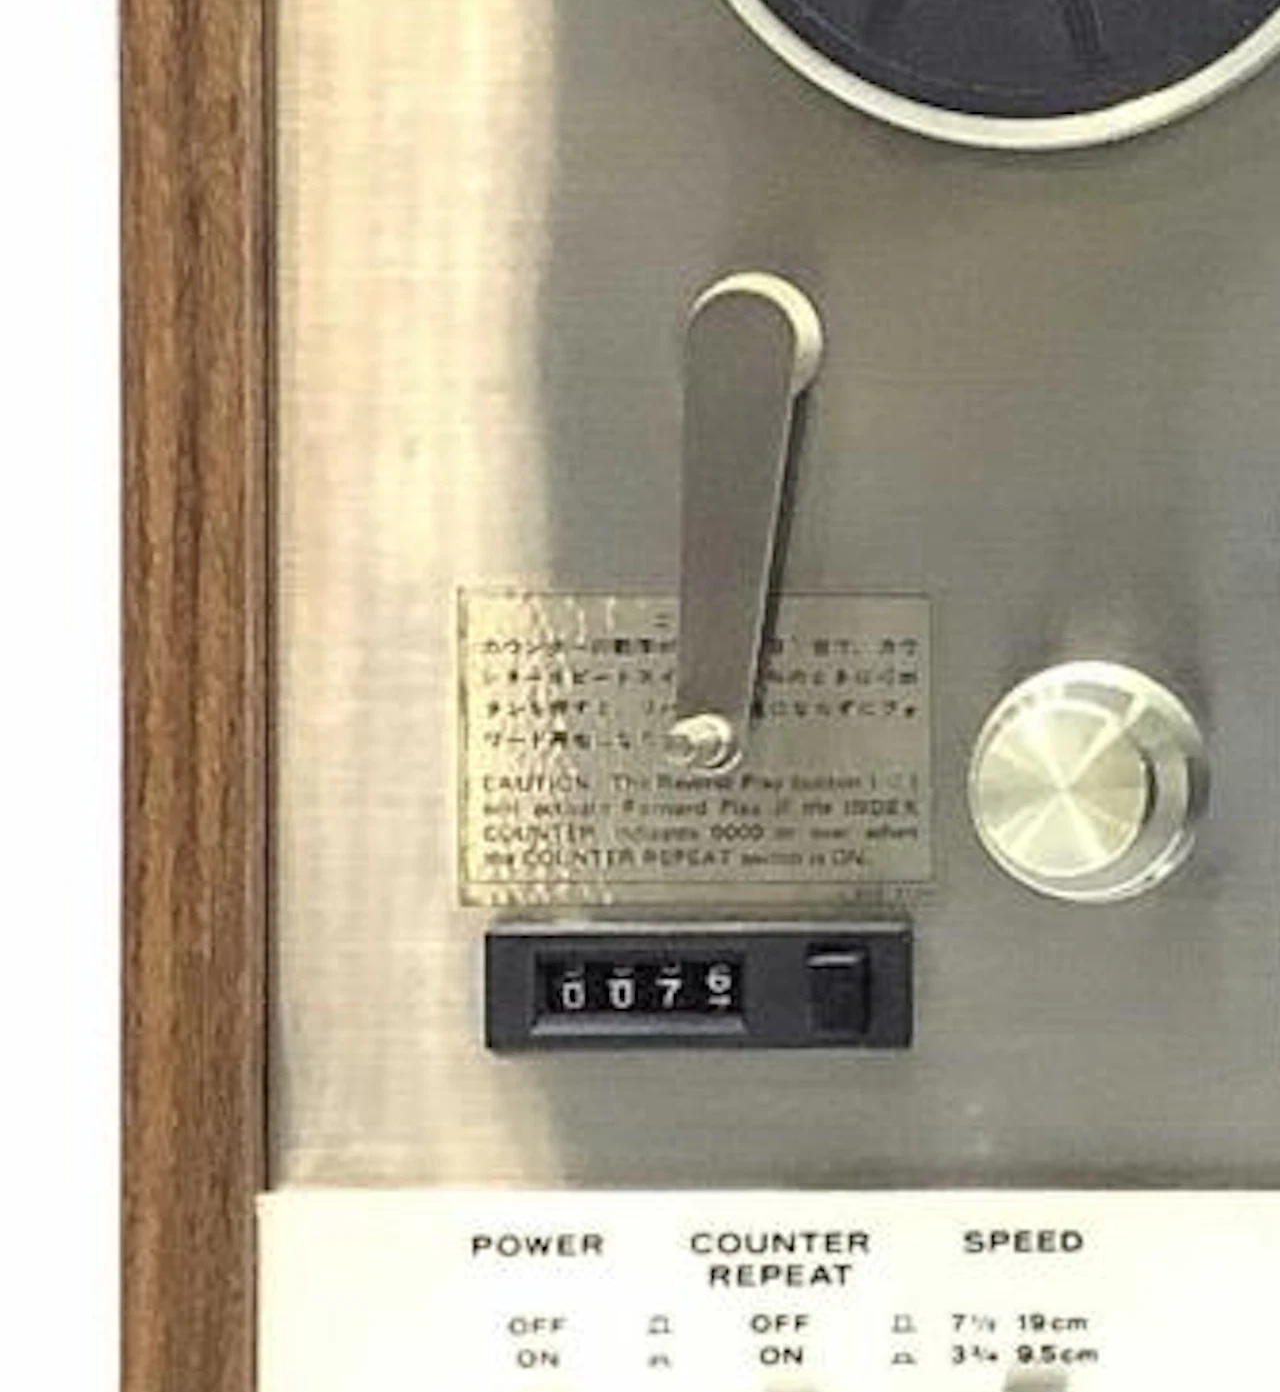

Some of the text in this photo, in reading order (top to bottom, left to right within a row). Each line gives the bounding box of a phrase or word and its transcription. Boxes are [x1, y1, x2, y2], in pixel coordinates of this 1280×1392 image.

[471, 1234, 604, 1257] POWER
[690, 1232, 870, 1255] COUNTER
[963, 1229, 1084, 1253] SPEED
[709, 1264, 852, 1287] REPEAT
[507, 1317, 565, 1336] OFF
[750, 1314, 810, 1334] OFF
[516, 1349, 560, 1368] ON
[759, 1347, 804, 1366] ON
